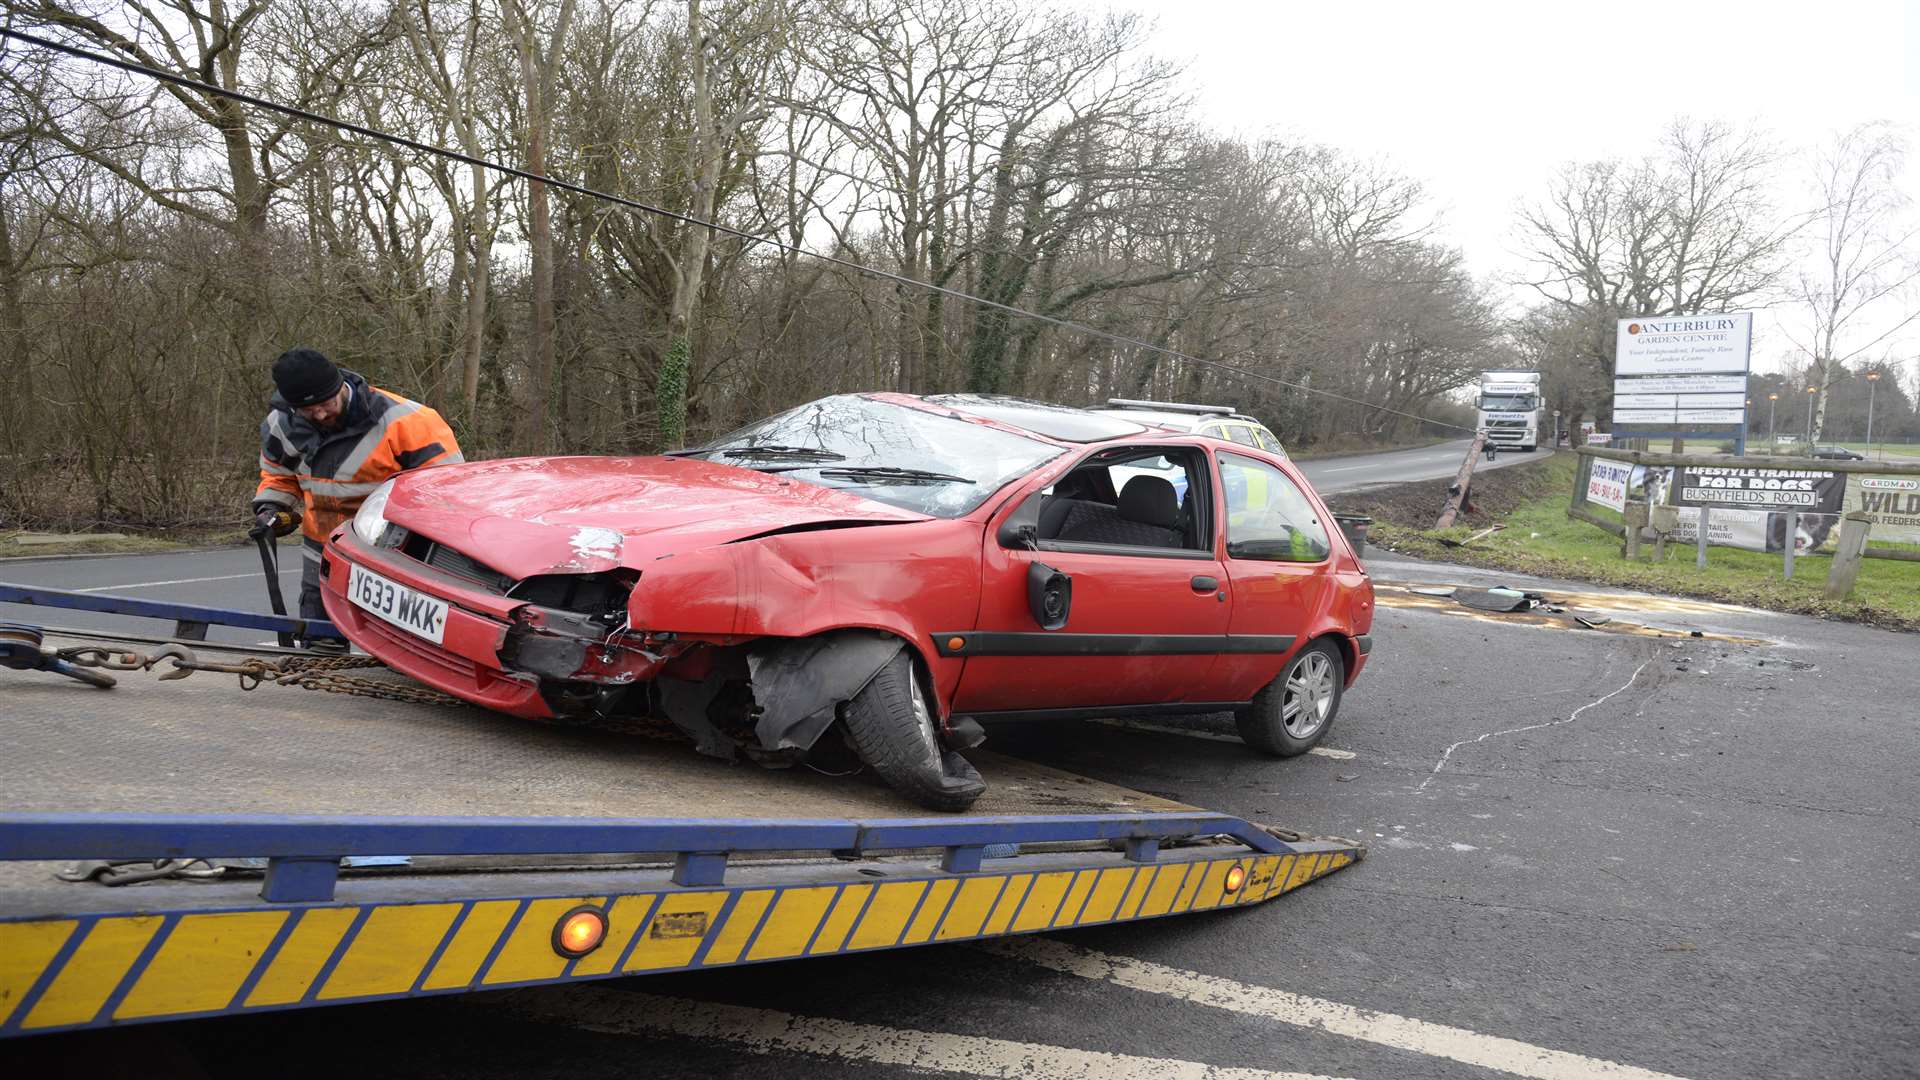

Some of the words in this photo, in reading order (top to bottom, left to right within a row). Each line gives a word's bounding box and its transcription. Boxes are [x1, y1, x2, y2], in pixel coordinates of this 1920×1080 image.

[1628, 320, 1737, 335] CANTERBURY
[1638, 336, 1680, 345] GARDEN
[1683, 334, 1728, 343] CENTRE
[1684, 467, 1756, 477] LIFESTYLE
[1758, 469, 1834, 479] TRAINING
[1698, 476, 1743, 488] FOR
[1749, 478, 1813, 491] DOGS
[1686, 488, 1765, 502] BUSHYFIELDS
[1773, 493, 1811, 504] ROAD
[1861, 491, 1920, 515] WILD
[356, 570, 394, 614] Y633
[398, 591, 438, 634] WKK
